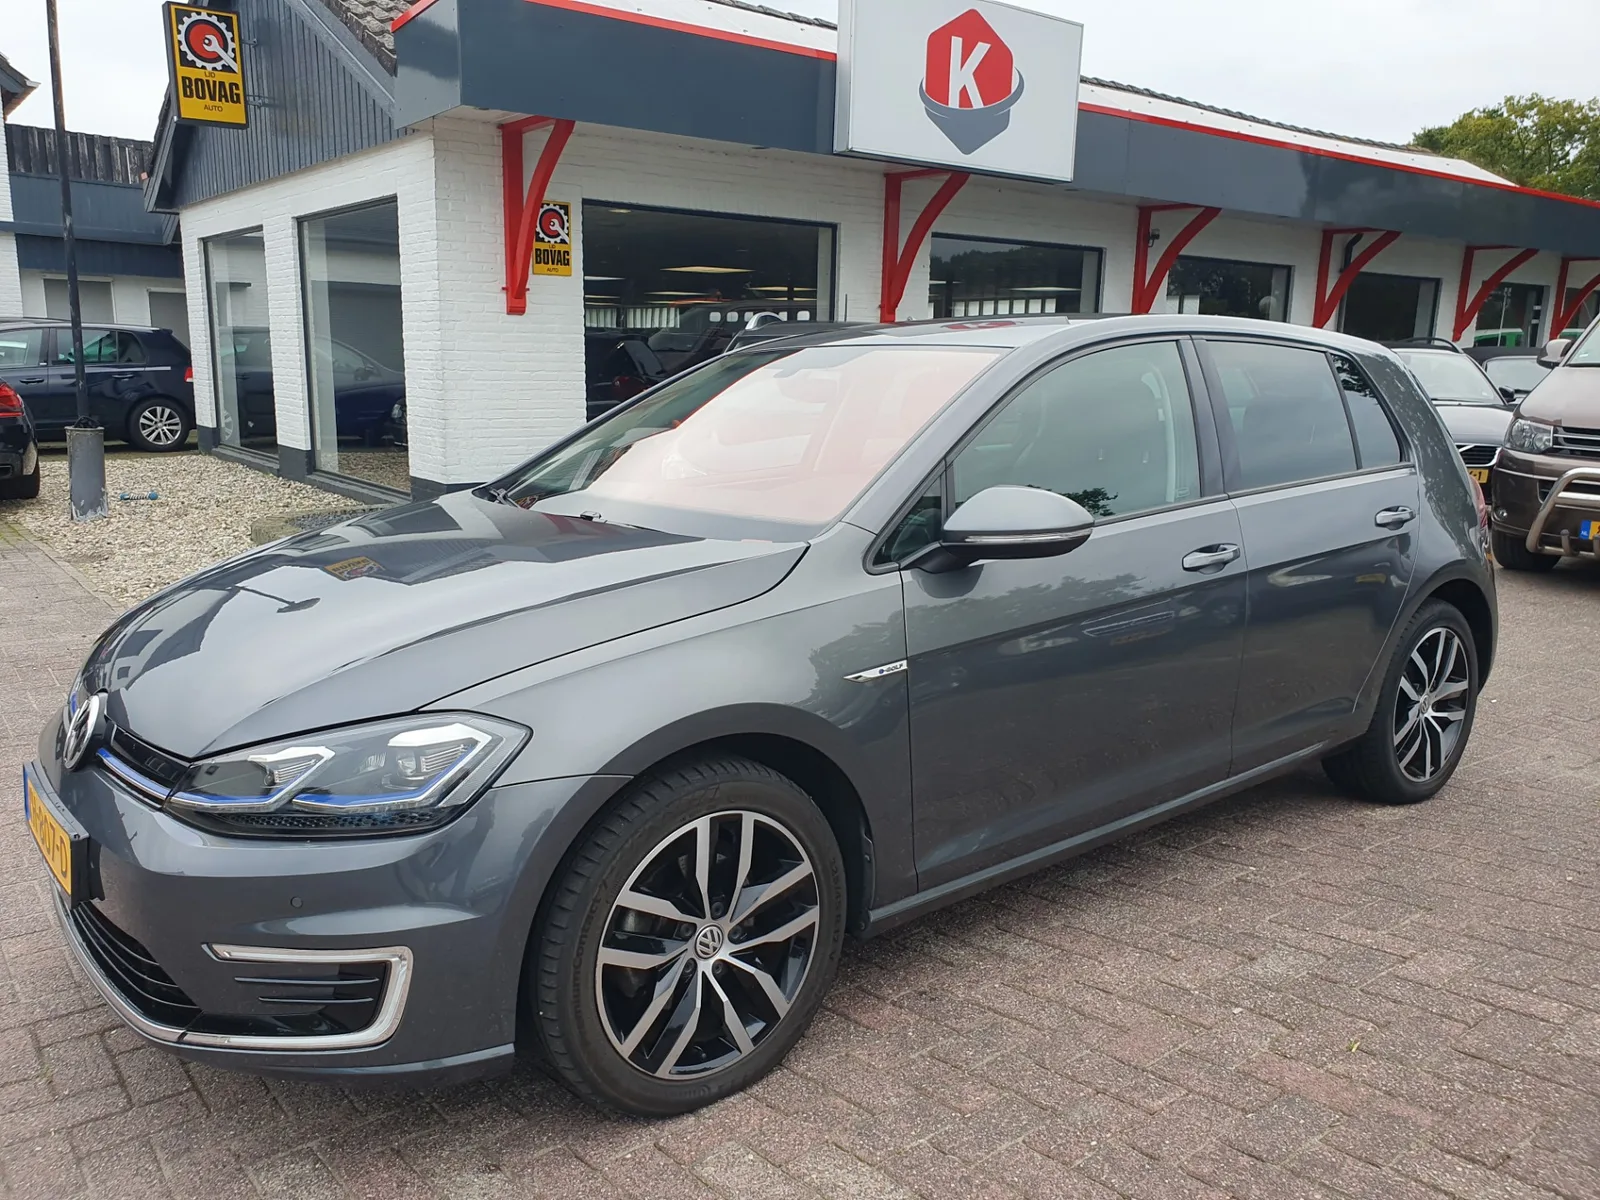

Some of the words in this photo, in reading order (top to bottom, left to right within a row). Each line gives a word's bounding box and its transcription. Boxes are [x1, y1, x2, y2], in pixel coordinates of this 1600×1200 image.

[948, 36, 991, 109] K
[181, 75, 242, 104] BOVAG
[204, 104, 223, 112] AUTO
[534, 248, 570, 266] BOVAG
